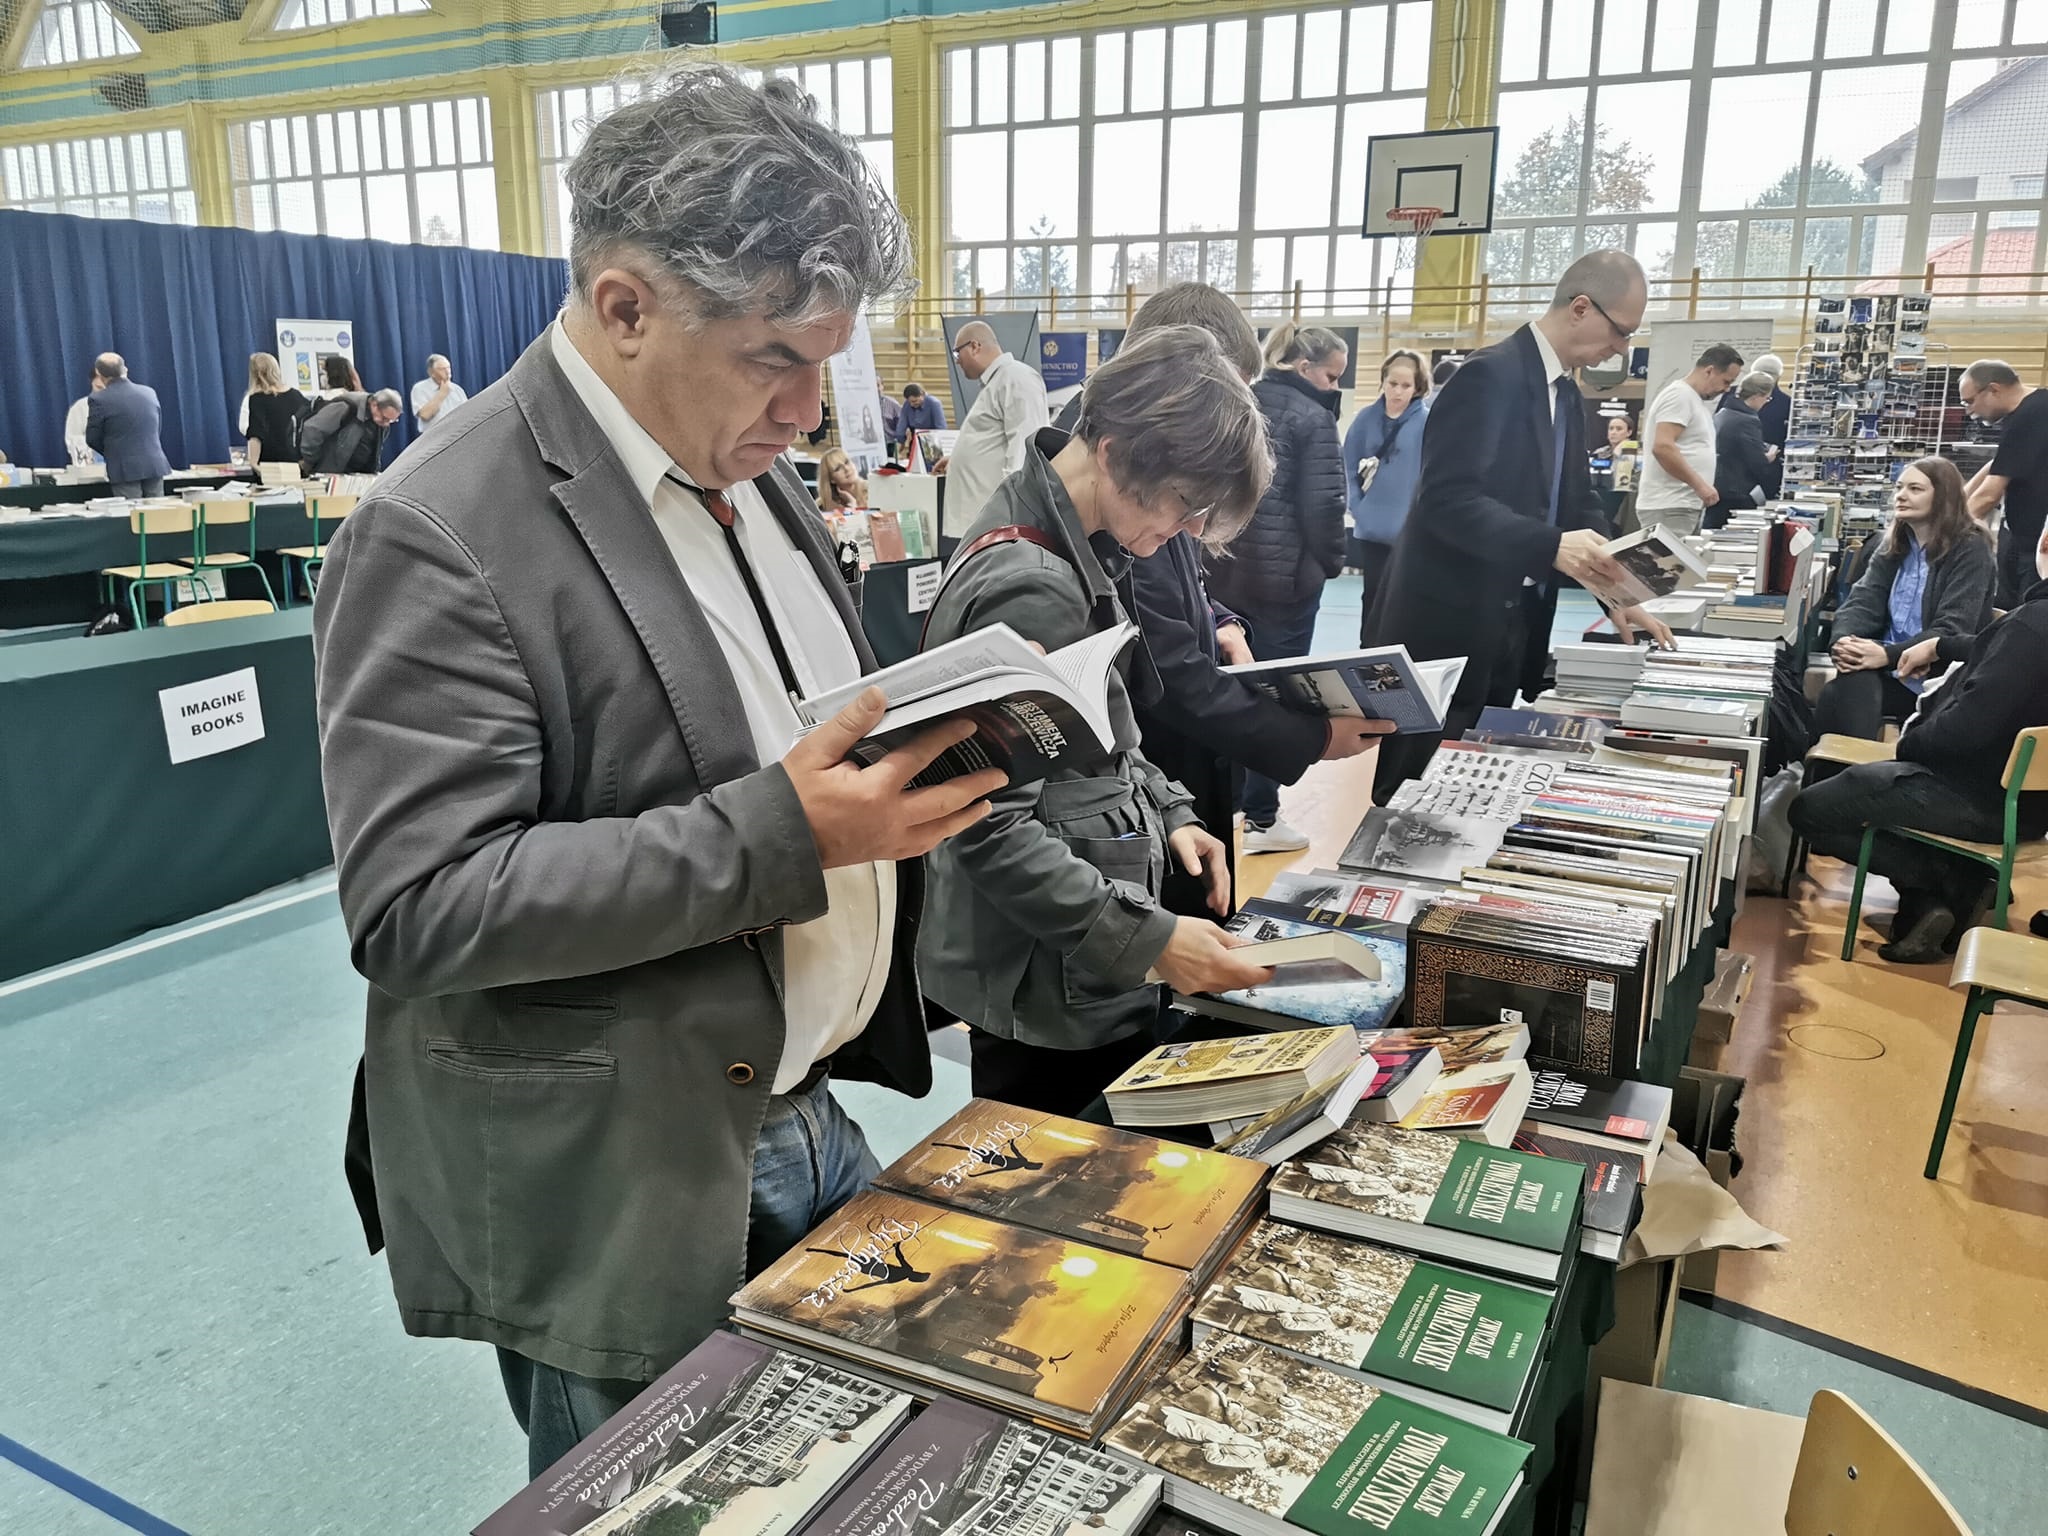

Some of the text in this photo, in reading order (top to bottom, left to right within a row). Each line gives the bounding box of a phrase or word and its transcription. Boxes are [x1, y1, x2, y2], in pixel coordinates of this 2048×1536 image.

[180, 689, 247, 718] IMAGINE
[191, 711, 245, 737] BOOKS
[1019, 700, 1068, 747] TESTAMENT
[1002, 702, 1060, 760] JAROSZEWICZA
[1599, 808, 1657, 823] WOJNIE
[1527, 1069, 1567, 1110] NOWEGO
[1552, 1079, 1589, 1107] ARMIA
[933, 1120, 1029, 1189] Bydgoszcz
[1468, 1159, 1522, 1224] TOWARZYSKIE
[1514, 1180, 1544, 1214] ZWYCZAJE
[802, 1217, 920, 1309] Bydgoszcz
[1412, 1287, 1482, 1372] TOWARZYSKIE
[1464, 1315, 1503, 1360] ZWYCZAJE
[631, 1377, 701, 1439] BYDGOSKIEGO
[638, 1394, 666, 1418] Rynek
[575, 1403, 707, 1504] Pozdrowienia
[600, 1418, 637, 1450] Mostowa
[1378, 1419, 1402, 1443] POLSKICH
[574, 1451, 598, 1473] Stary
[583, 1434, 634, 1479] STAREGO
[1333, 1441, 1374, 1488] RZECZYPOSPOLITEJ
[1347, 1425, 1449, 1531] TOWARZYSKIE
[537, 1475, 585, 1512] MIASTA
[546, 1467, 578, 1496] Rynek
[838, 1452, 915, 1529] Rybi Rynek Mostowa
[869, 1449, 933, 1517] BYDGOSKIEGO
[1329, 1475, 1361, 1510] BYDGOSZCZY
[1412, 1463, 1466, 1518] ZWYCZAJE
[1459, 1485, 1487, 1519] EWA RYNKA
[848, 1514, 874, 1536] STA
[871, 1478, 944, 1536] Pozdro
